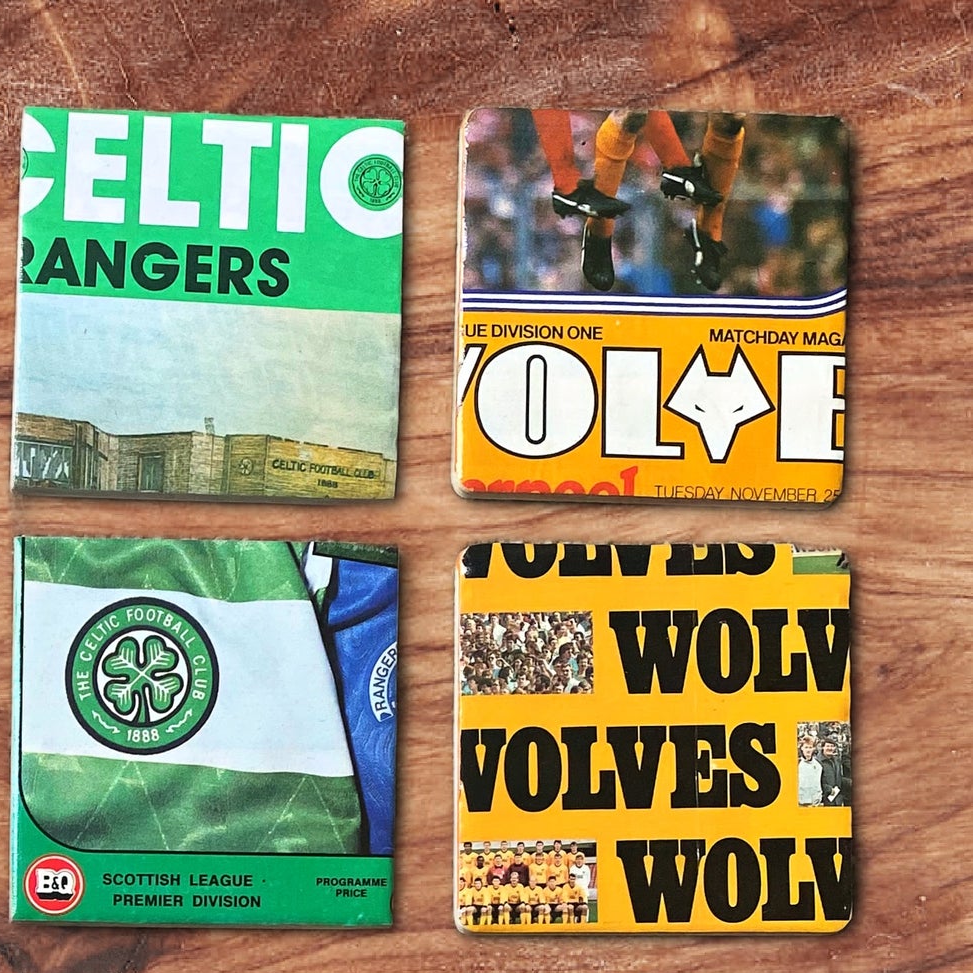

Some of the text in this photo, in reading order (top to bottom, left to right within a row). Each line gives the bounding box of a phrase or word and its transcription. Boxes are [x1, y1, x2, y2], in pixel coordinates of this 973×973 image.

[461, 324, 487, 337] UE
[491, 325, 563, 339] DIVISION
[567, 326, 603, 340] ONE
[709, 329, 799, 345] MATCHDAY
[272, 459, 306, 472] CELTIC
[309, 463, 351, 477] FOOTBALL
[655, 485, 724, 499] TUESDAY
[731, 487, 816, 502] NOVEMBER
[77, 608, 208, 701] THE CELTIC FOOTBALL CLUB
[127, 728, 160, 743] 1888
[35, 868, 76, 902] B&Q
[102, 873, 253, 887] SCOTTISH LEAGUE
[315, 877, 387, 887] PROGRAMME
[113, 894, 261, 908] PREMIER DIVISION
[335, 889, 368, 898] PRICE
